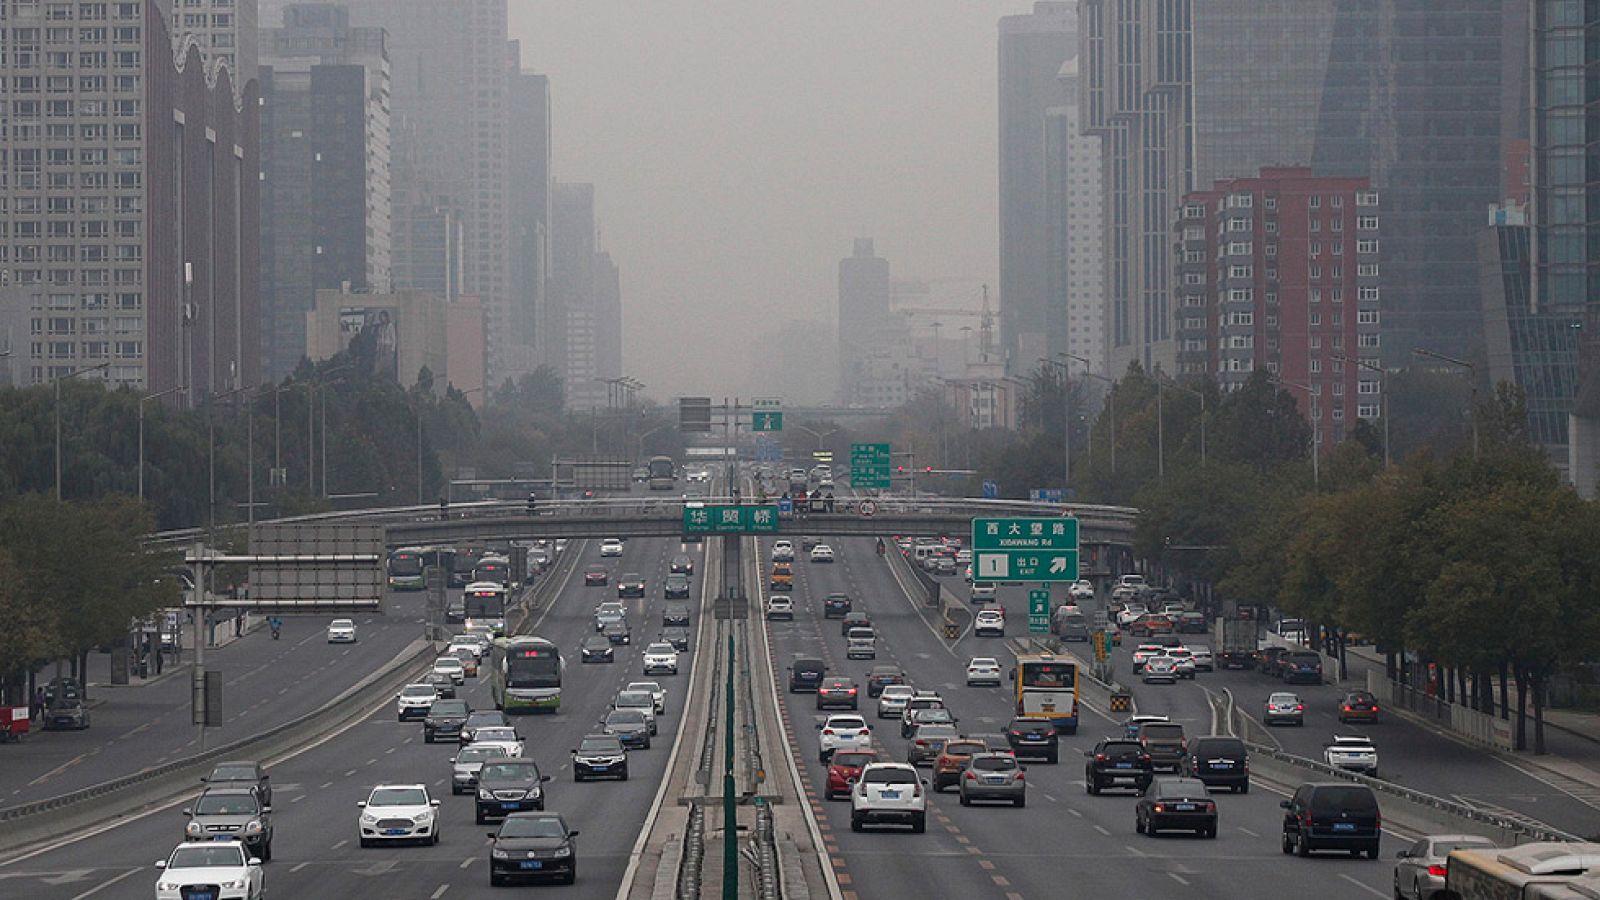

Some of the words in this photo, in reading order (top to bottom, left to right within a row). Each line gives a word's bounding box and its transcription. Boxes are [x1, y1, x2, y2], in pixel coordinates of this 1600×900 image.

[986, 522, 1065, 535] 西大望路
[992, 559, 997, 572] 1
[1017, 557, 1039, 567] 出口
